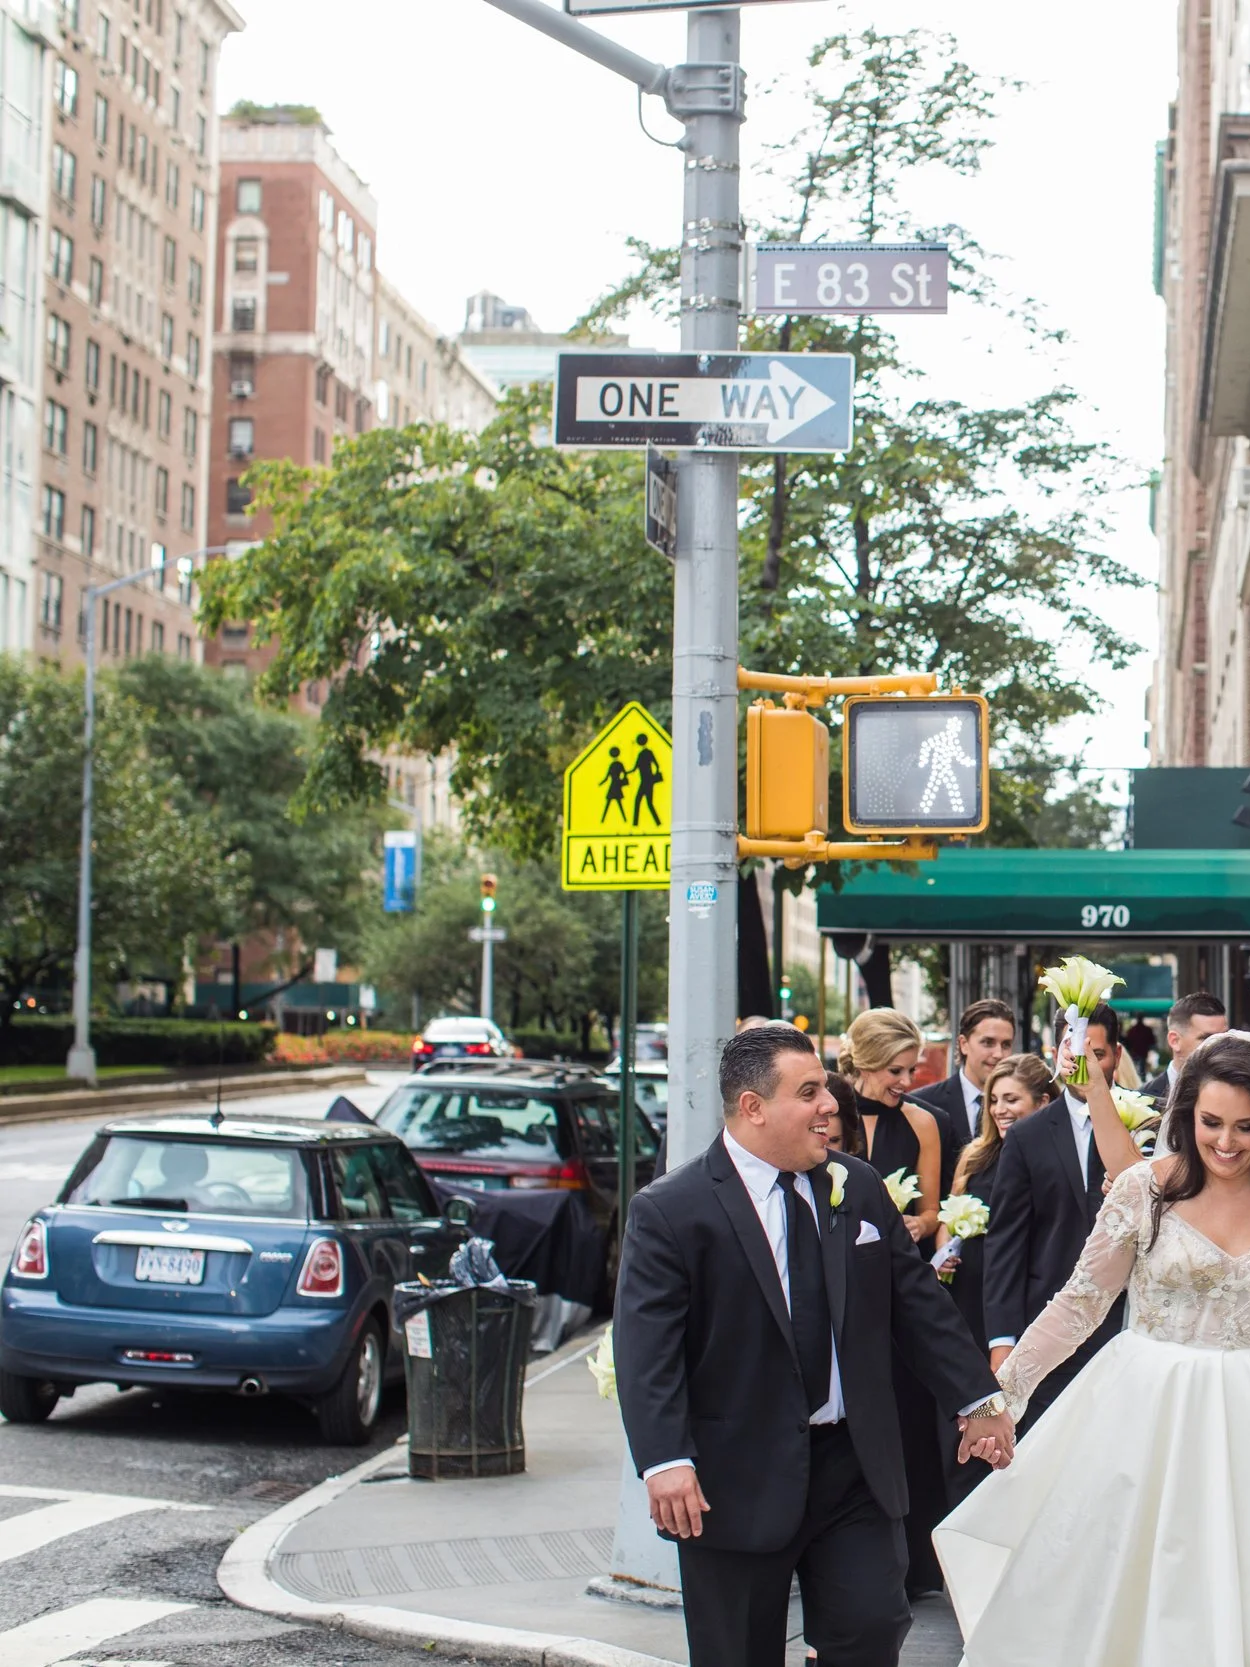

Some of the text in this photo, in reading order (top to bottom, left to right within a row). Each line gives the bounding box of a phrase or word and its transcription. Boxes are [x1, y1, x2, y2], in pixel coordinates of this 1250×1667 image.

[774, 262, 932, 307] E 83 St
[600, 382, 807, 420] ONE WAY
[1081, 904, 1130, 928] 970
